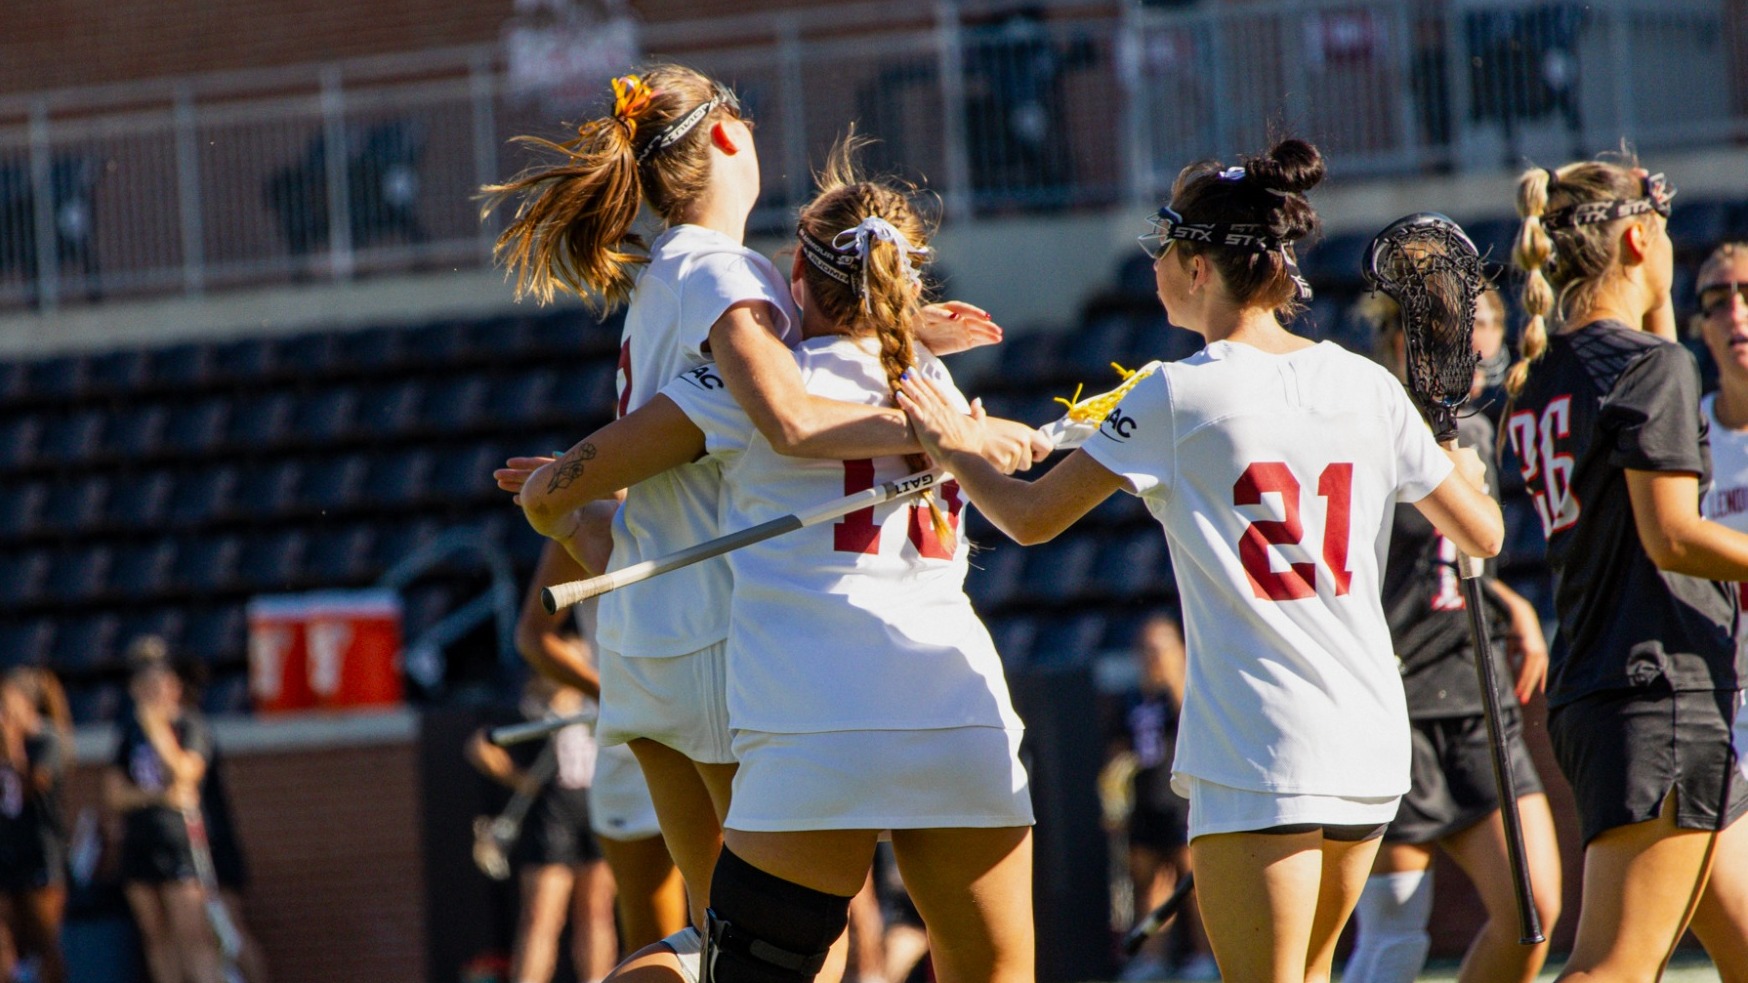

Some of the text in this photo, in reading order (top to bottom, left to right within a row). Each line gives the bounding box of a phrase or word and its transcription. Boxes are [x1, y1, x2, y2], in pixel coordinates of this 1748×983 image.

[1174, 226, 1213, 243] STX
[688, 366, 725, 391] AC
[1103, 408, 1137, 438] AC
[1508, 393, 1582, 542] 26
[1233, 461, 1354, 602] 21
